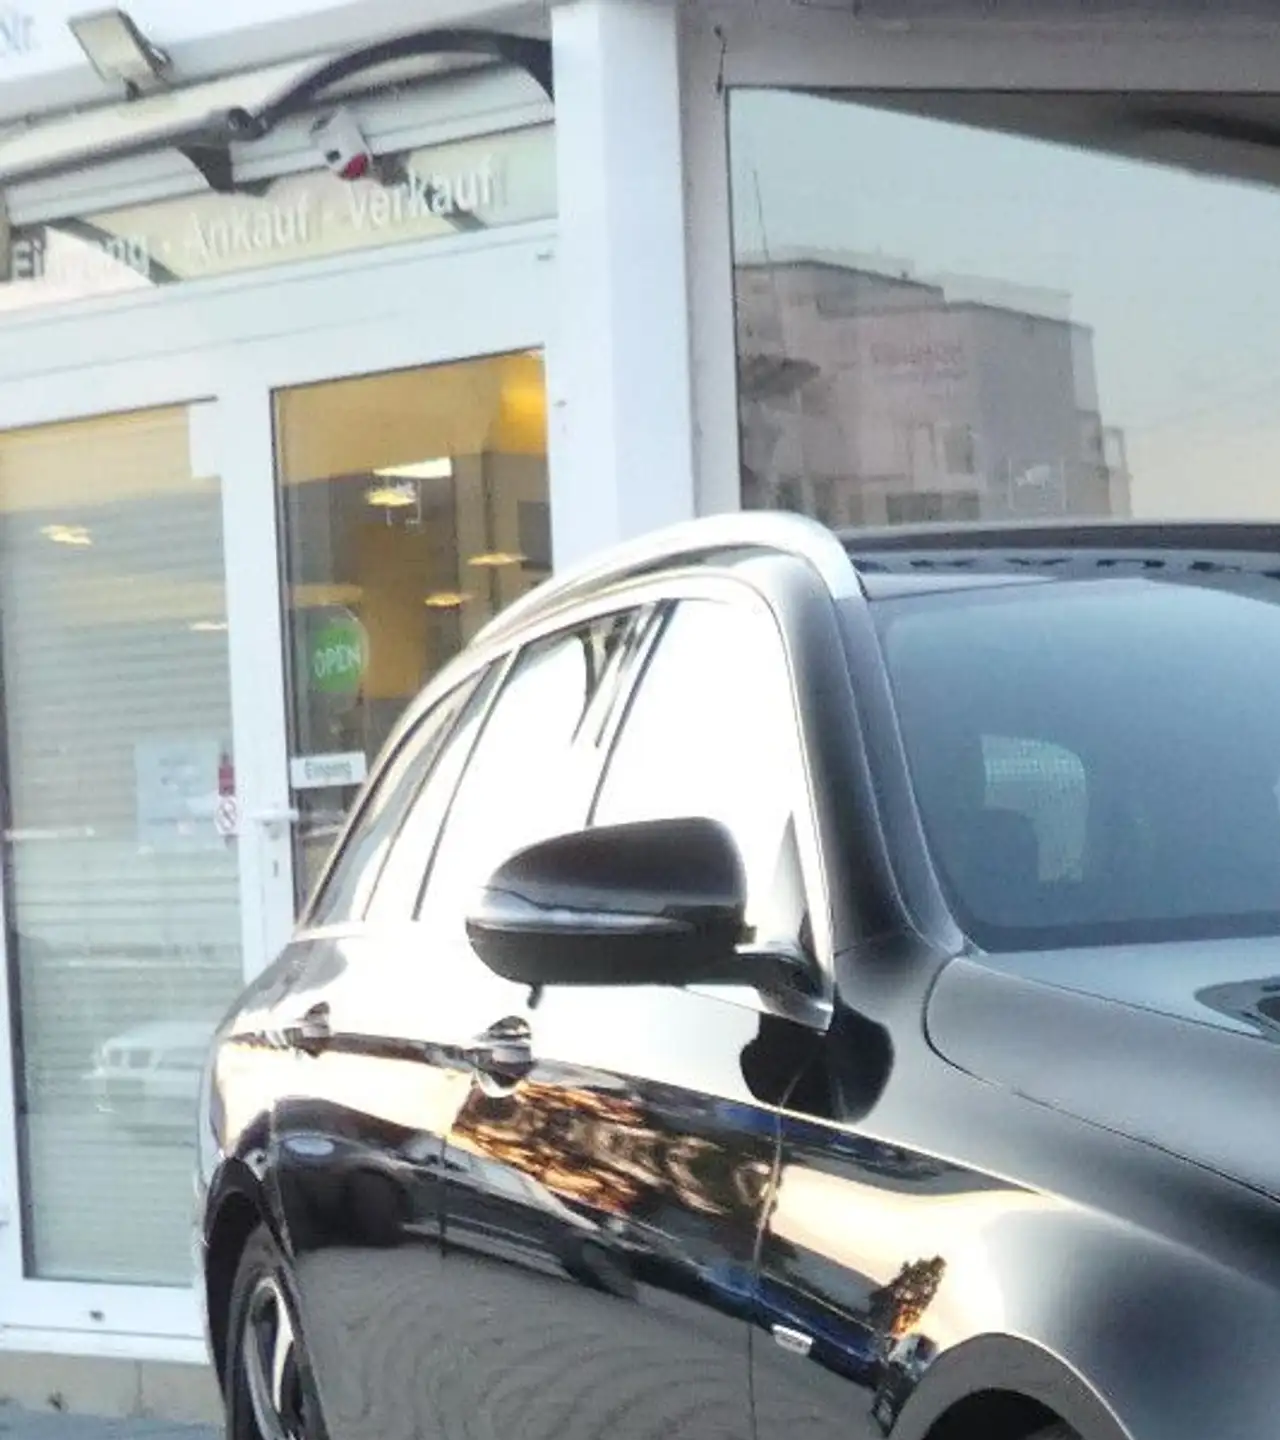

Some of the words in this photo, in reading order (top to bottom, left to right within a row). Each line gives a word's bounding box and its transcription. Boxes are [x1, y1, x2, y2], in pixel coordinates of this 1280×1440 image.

[190, 190, 310, 260] Ankauf
[346, 165, 496, 231] Verkauf
[315, 643, 361, 678] OPEN
